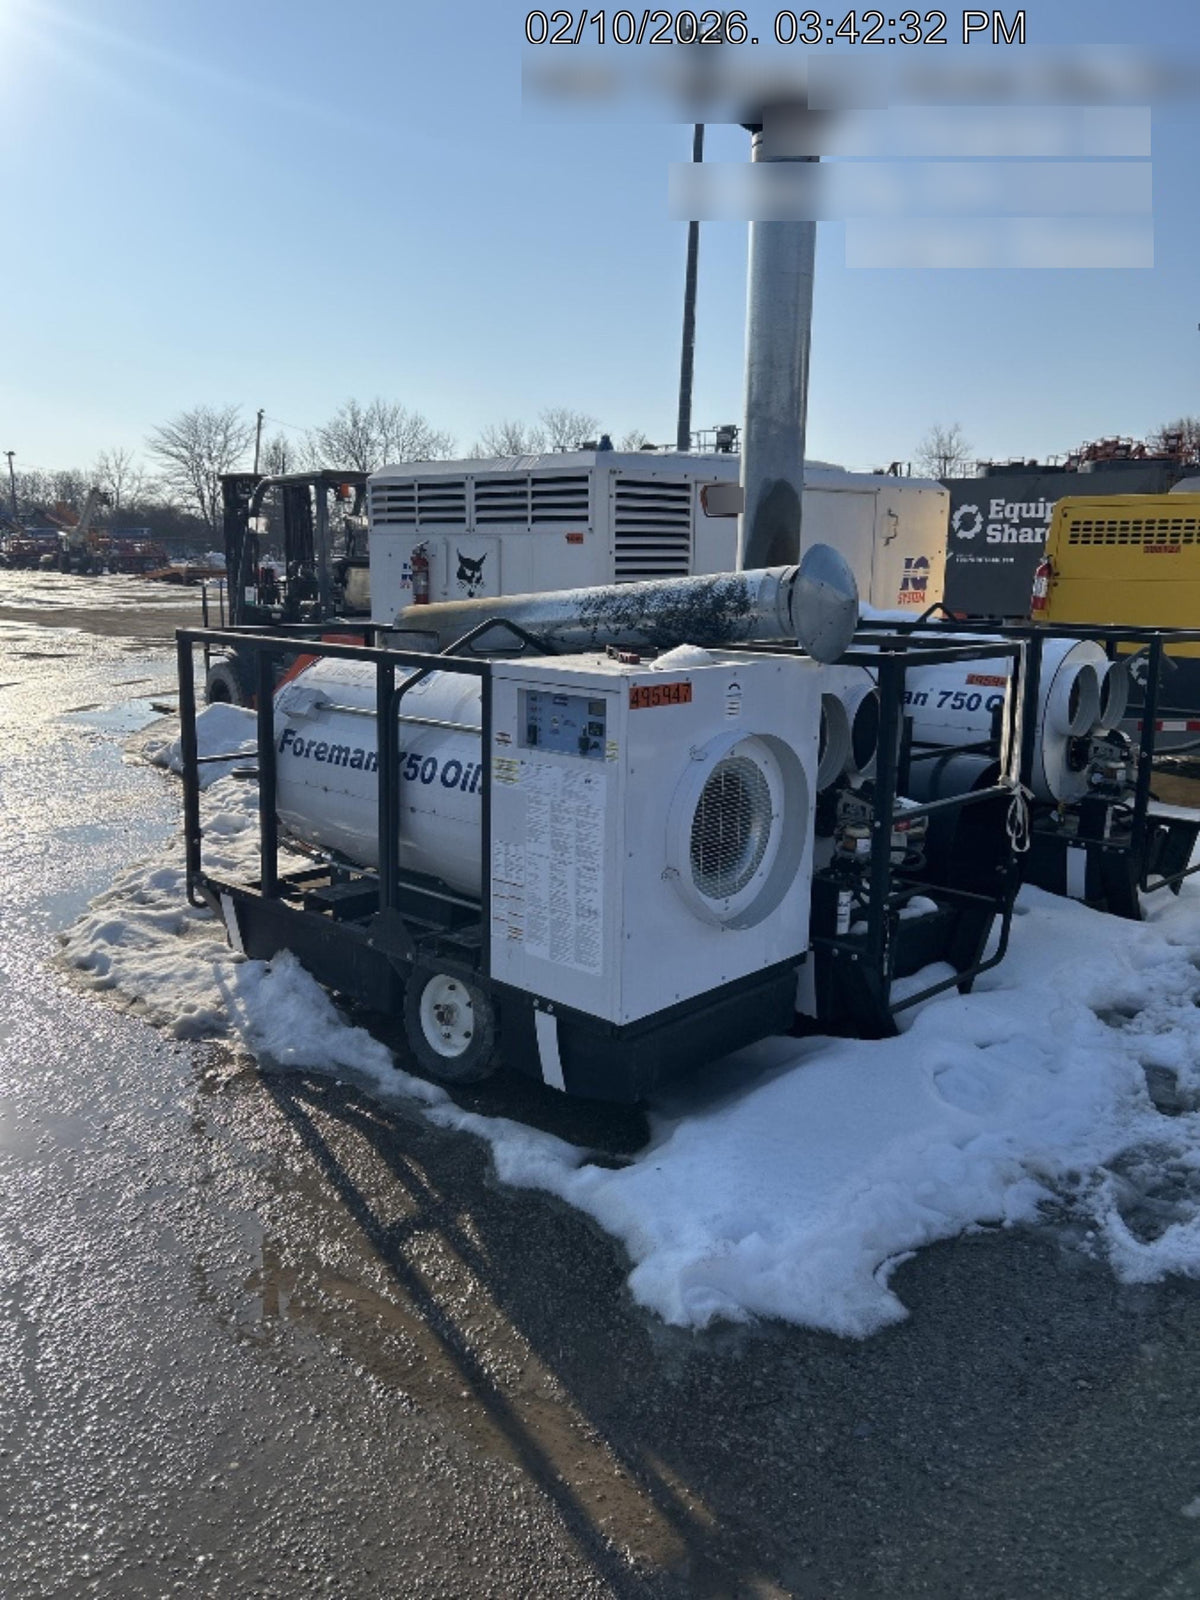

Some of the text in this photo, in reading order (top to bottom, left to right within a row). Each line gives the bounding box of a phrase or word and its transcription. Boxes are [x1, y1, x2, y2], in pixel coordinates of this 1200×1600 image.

[988, 498, 1056, 523] Equip
[629, 682, 691, 709] 495947
[937, 691, 982, 711] 750
[279, 728, 379, 773] Foreman
